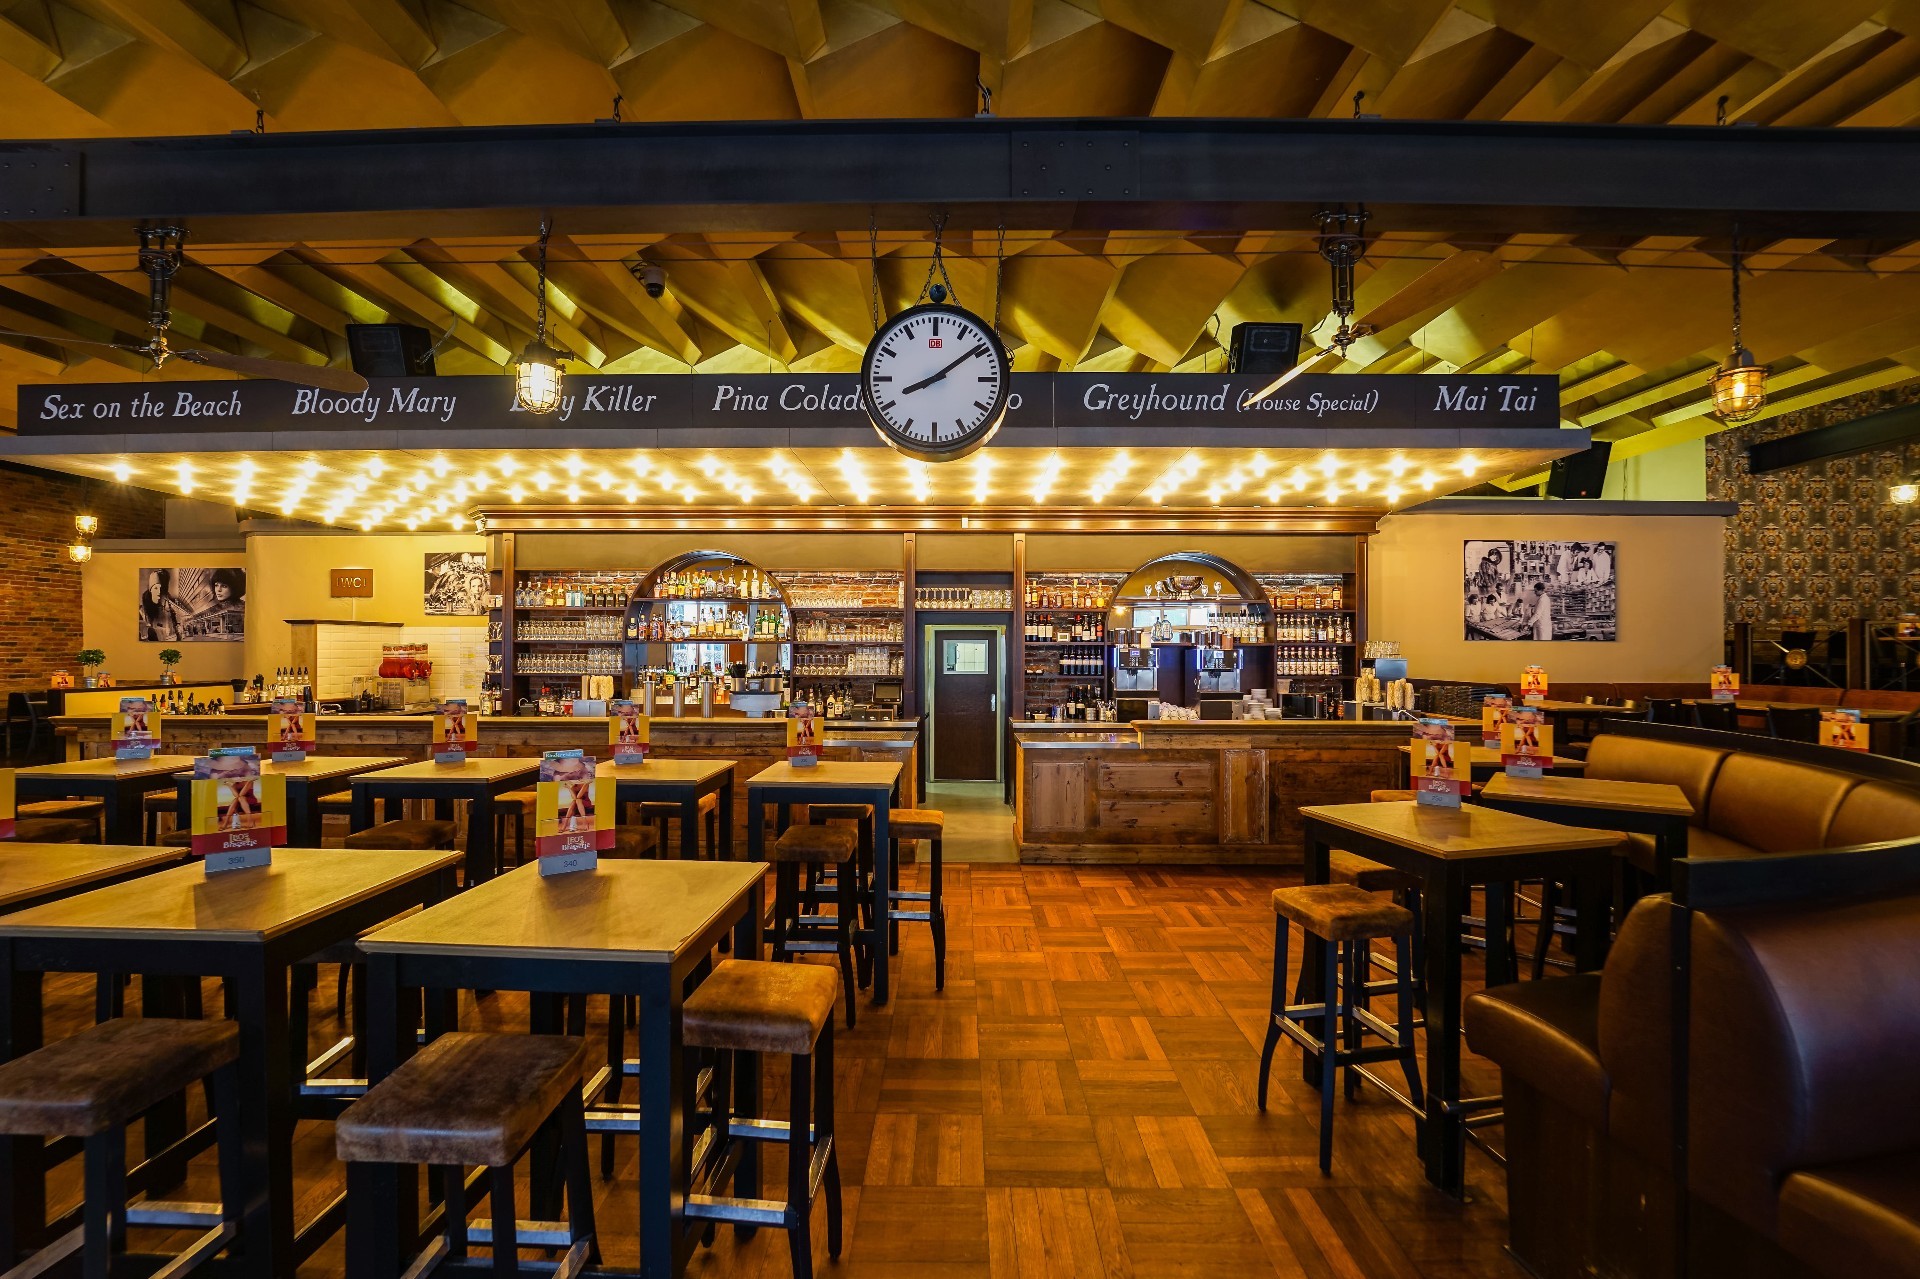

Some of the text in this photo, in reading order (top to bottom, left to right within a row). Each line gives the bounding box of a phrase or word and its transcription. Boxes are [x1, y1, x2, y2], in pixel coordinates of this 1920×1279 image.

[40, 390, 242, 419] Sex on the Beach
[292, 387, 456, 422] Bloody Mary
[582, 385, 657, 412] Killer
[712, 385, 768, 411] Pina
[1083, 383, 1230, 419] Greyhound
[1306, 389, 1379, 417] Special)
[1433, 386, 1538, 411] Mai Tai
[341, 577, 361, 587] WC
